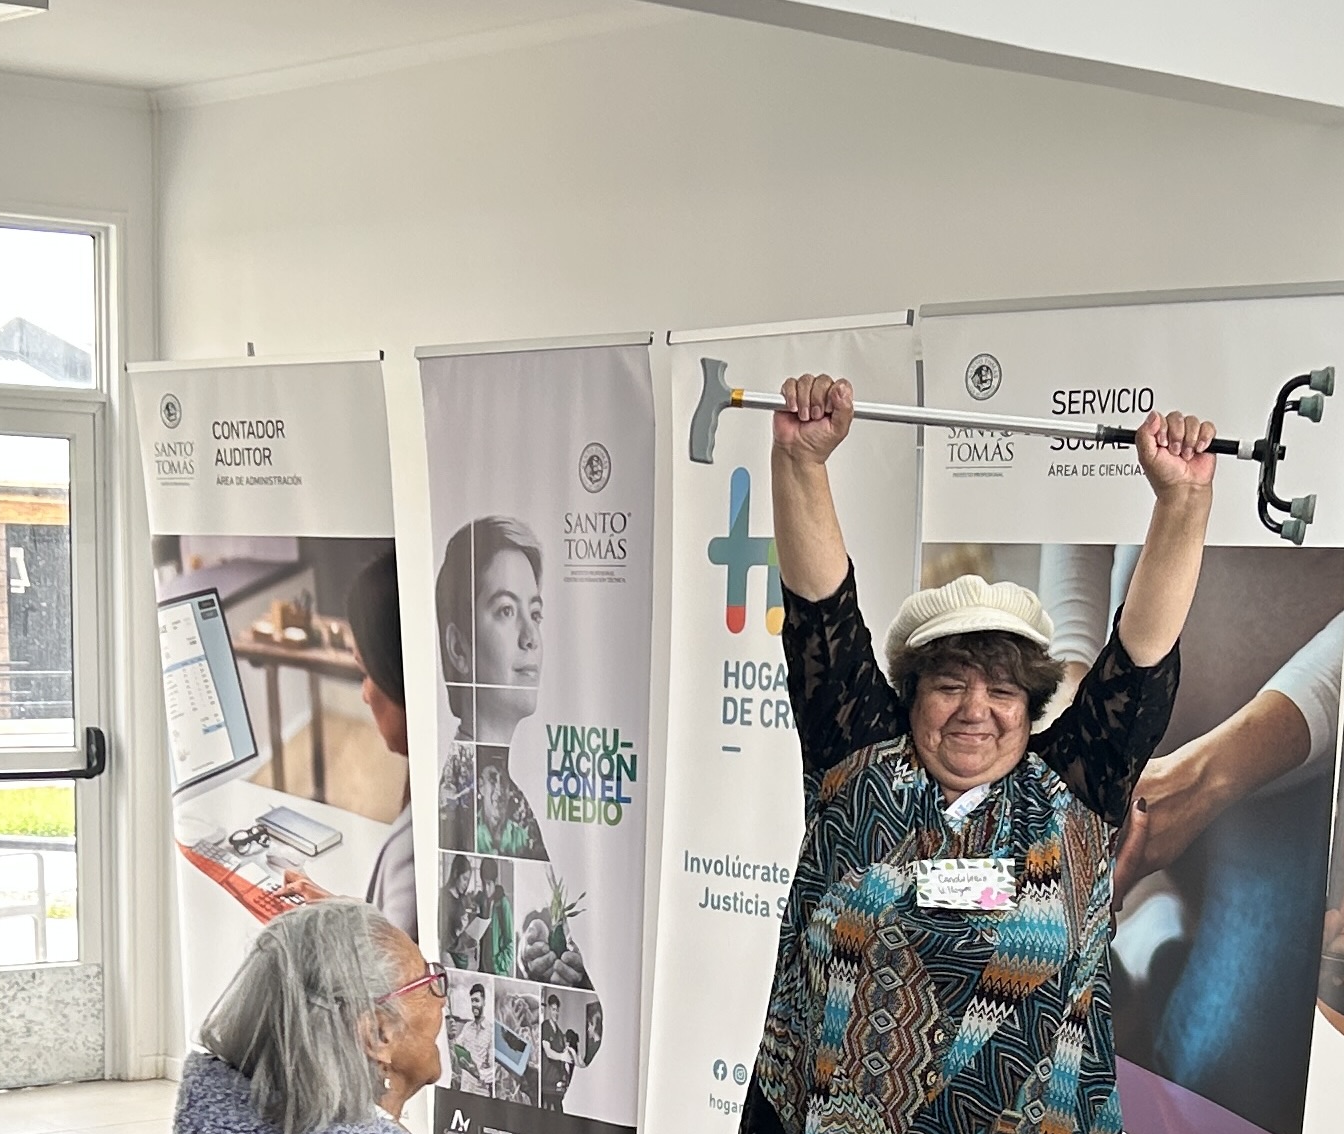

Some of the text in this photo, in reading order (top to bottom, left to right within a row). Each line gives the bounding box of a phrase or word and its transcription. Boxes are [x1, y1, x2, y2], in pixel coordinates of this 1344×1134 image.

[1052, 387, 1154, 415] SERVICIO
[212, 420, 286, 440] CONTADOR
[154, 441, 194, 458] SANTO
[215, 447, 273, 467] AUDITOR
[947, 438, 1014, 462] TOMÁS
[155, 456, 195, 475] TOMÁS
[1048, 462, 1078, 476] ÁREA
[1082, 464, 1096, 476] DE
[216, 473, 302, 486] ÁREA DE ADMINISTRACIÓN
[564, 512, 627, 534] SANTO
[564, 534, 627, 560] TOMÁS
[722, 696, 753, 726] DE
[546, 724, 633, 755] VINCU-
[547, 772, 632, 804] CON EL
[546, 794, 622, 826] MEDIO
[684, 849, 790, 885] Involúcrate
[698, 886, 770, 918] Justicia
